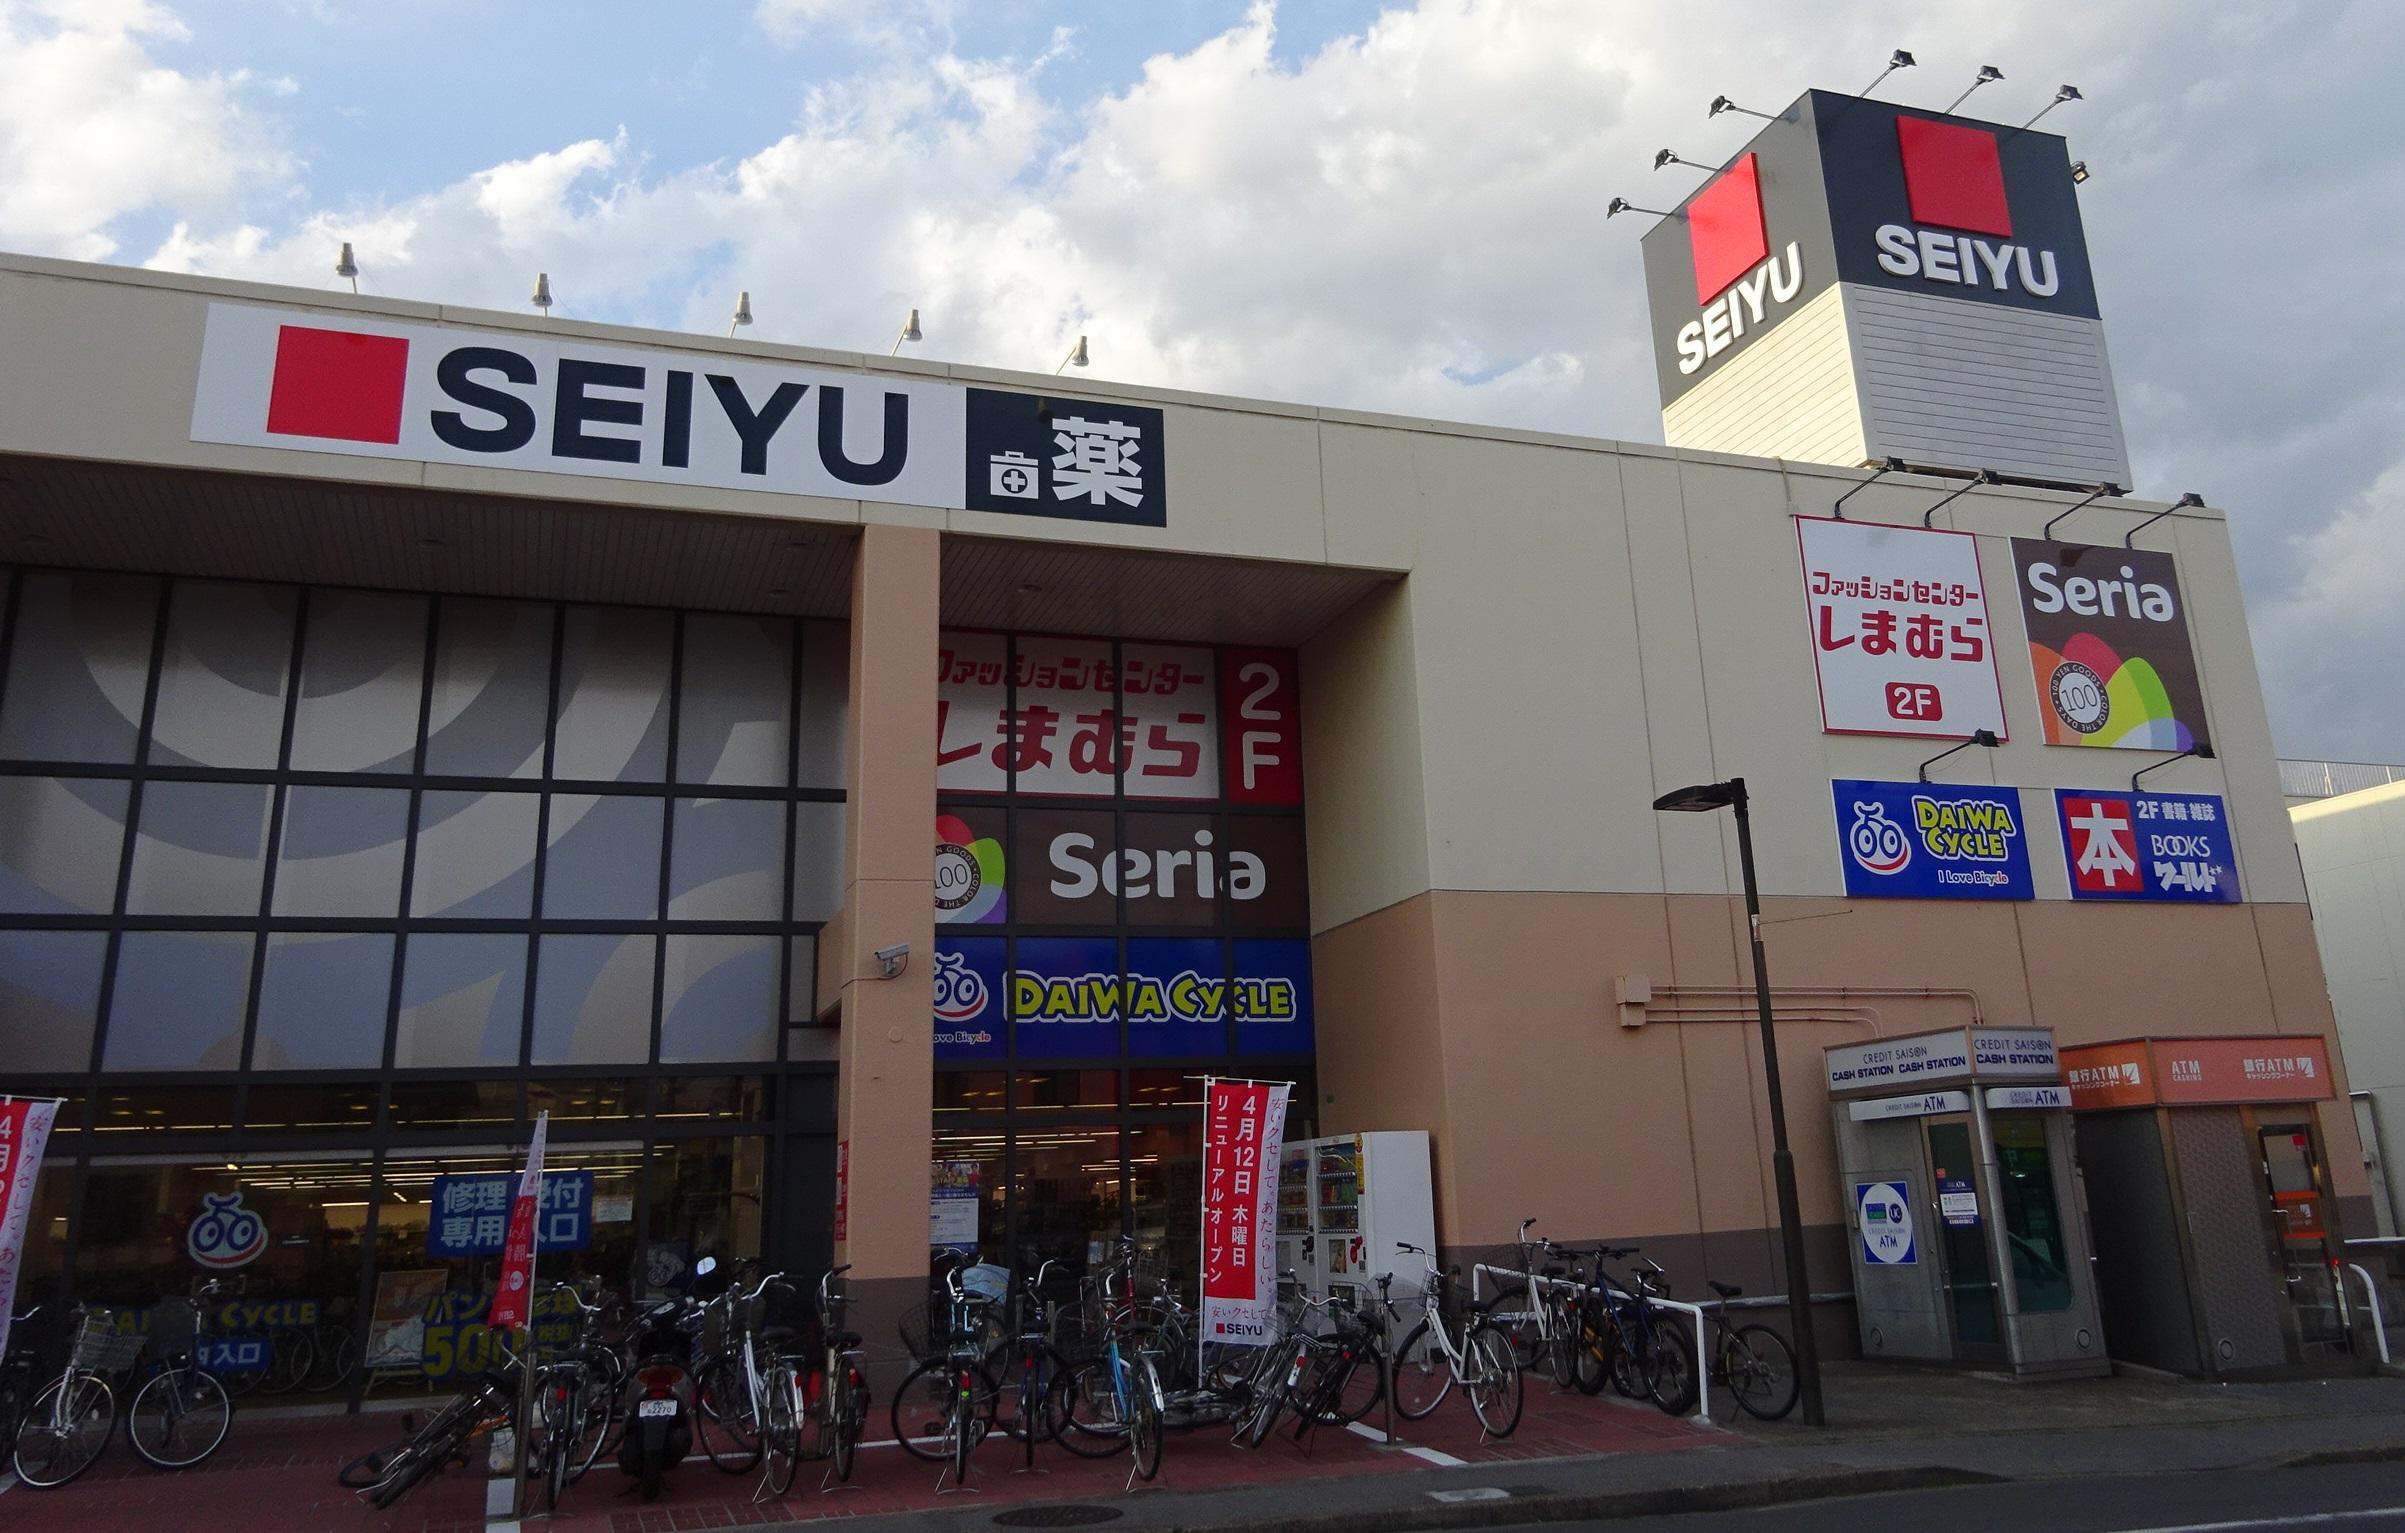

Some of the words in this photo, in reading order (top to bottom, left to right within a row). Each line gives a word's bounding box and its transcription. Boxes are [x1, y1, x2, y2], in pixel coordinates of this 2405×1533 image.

[1875, 224, 2060, 297] SEIYU
[1676, 241, 1803, 376] SEIYU
[430, 346, 910, 487] SEIYU
[1051, 417, 1144, 508] 薬
[1812, 571, 1979, 607] ファッションセンター
[2027, 562, 2174, 622] Seria
[1819, 604, 1984, 663] しまむら
[2072, 664, 2100, 688] GOODS
[1893, 686, 1932, 716] 2F
[2061, 684, 2098, 712] 100
[937, 700, 1206, 778] しまむら
[1238, 662, 1282, 790] 2F
[1915, 799, 2013, 832] DAIWA
[2136, 800, 2160, 820] 2F
[1925, 828, 2005, 857] CYCLE
[2070, 802, 2136, 887] 本
[2150, 834, 2211, 858] BOOKS
[935, 863, 968, 889] 00
[1049, 829, 1266, 900] Seria
[1938, 870, 1944, 883] I
[1947, 870, 1973, 884] Love
[1974, 870, 2009, 887] Bicycle
[2153, 861, 2223, 893] ワールド
[1013, 972, 1168, 1017] DAIWA
[1172, 970, 1294, 1019] CYCLE
[934, 1033, 954, 1043] ove
[955, 1031, 991, 1044] Bicycle
[1973, 1039, 2010, 1051] CREDIT
[2014, 1039, 2052, 1052] SAISON
[1832, 1070, 1856, 1082] CASH
[1857, 1065, 1894, 1079] STATION
[1898, 1062, 1925, 1074] CASH
[1926, 1055, 1966, 1070] STATION
[1863, 1050, 1893, 1066] CREDIT
[1895, 1046, 1928, 1061] SAISON
[1976, 1054, 2007, 1065] CASH
[2010, 1054, 2054, 1065] STATION
[2171, 1060, 2201, 1075] ATM
[1923, 1096, 1946, 1112] ATM
[2035, 1090, 2060, 1105] ATM
[1233, 1094, 1256, 1196] 4月12日
[1210, 1094, 1229, 1284] リニューアルオープン
[1231, 1203, 1249, 1268] 木曜日
[1879, 1235, 1898, 1248] ATM
[221, 1301, 318, 1329] CYCLE
[1226, 1322, 1263, 1336] SEIYU
